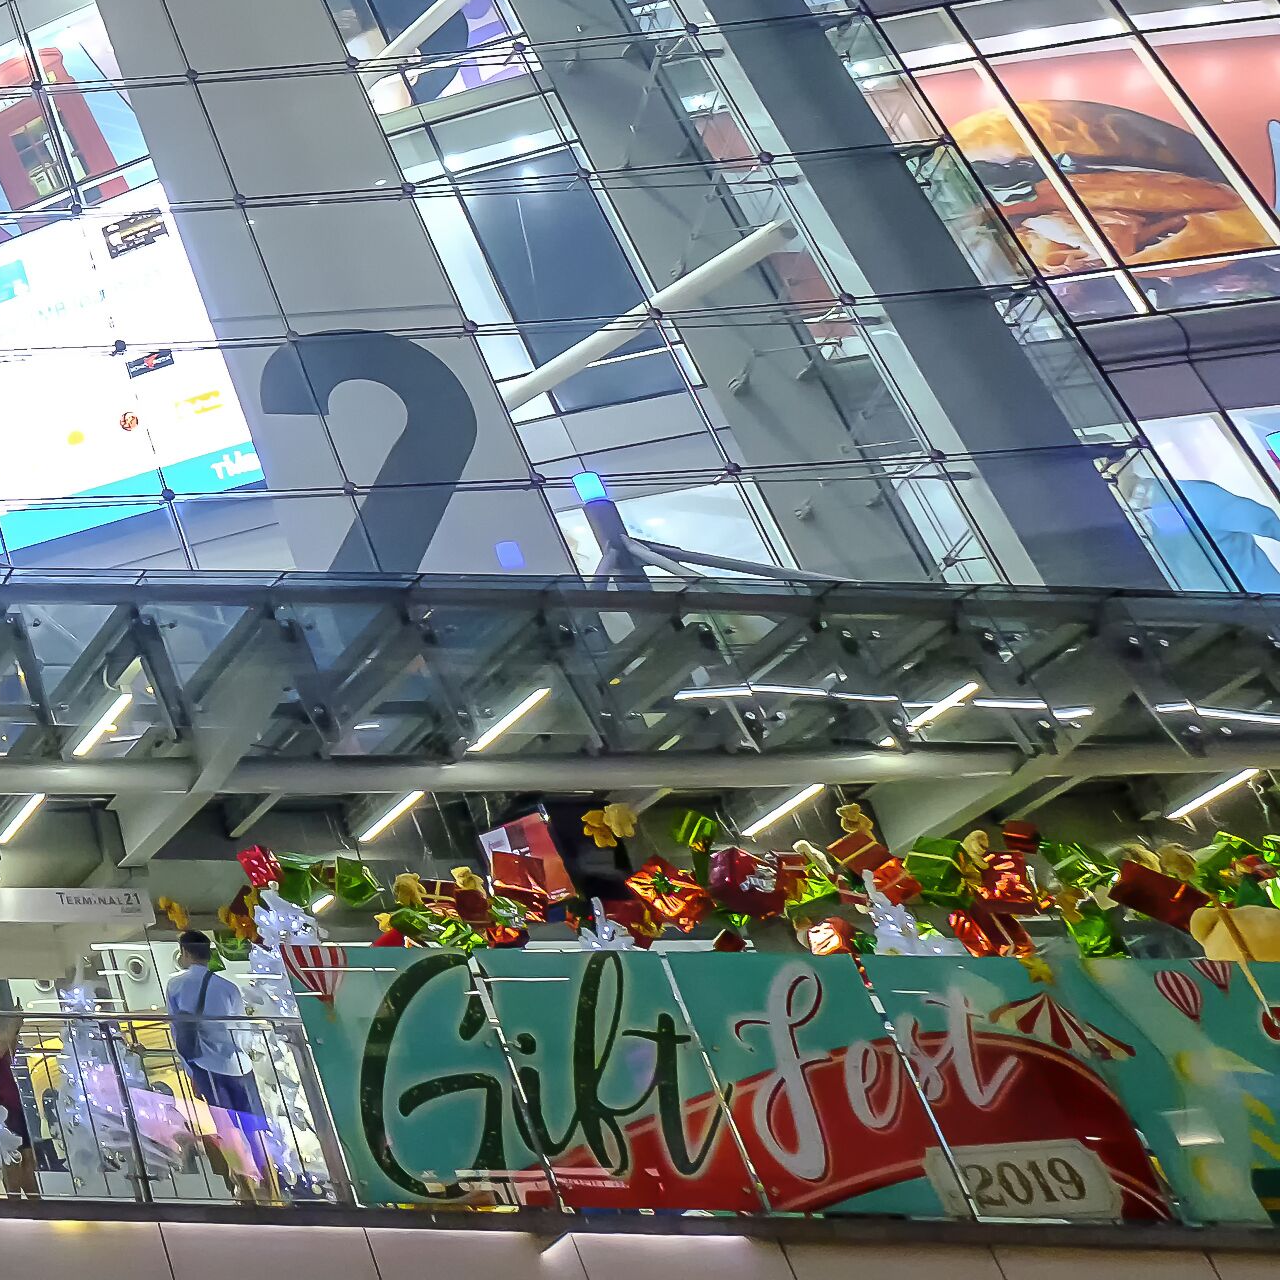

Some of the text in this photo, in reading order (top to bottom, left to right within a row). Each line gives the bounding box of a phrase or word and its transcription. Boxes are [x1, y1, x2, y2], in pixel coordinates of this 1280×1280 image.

[359, 951, 1018, 1201] Gift Fest
[966, 1138, 1087, 1208] 2019
